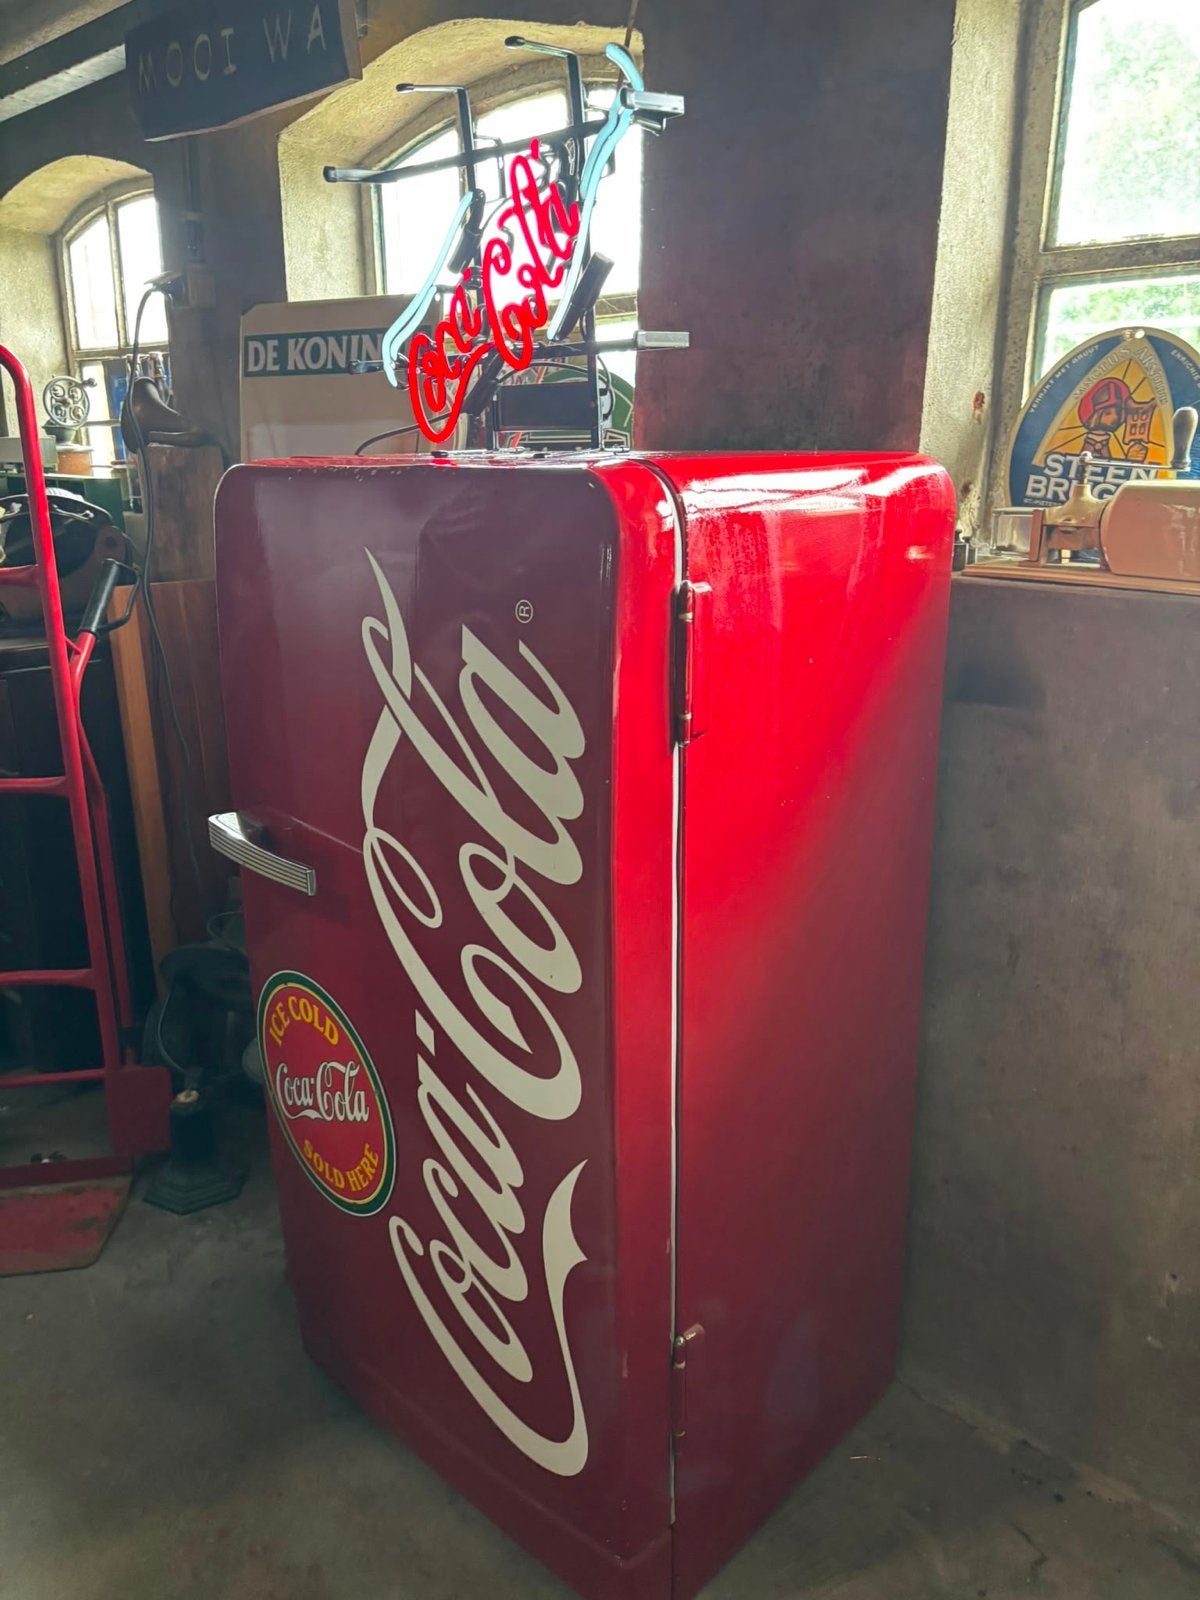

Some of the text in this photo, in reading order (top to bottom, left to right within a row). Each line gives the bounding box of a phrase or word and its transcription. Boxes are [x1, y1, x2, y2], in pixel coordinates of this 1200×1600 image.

[138, 28, 237, 94] MOOI
[248, 332, 392, 372] DE KONIN
[1043, 454, 1159, 485] STEEN
[269, 996, 339, 1047] ICE COLD
[361, 546, 590, 1477] Coca-Cola
[276, 1061, 369, 1122] Coca-Cola
[303, 1139, 379, 1192] SOLD HERE
